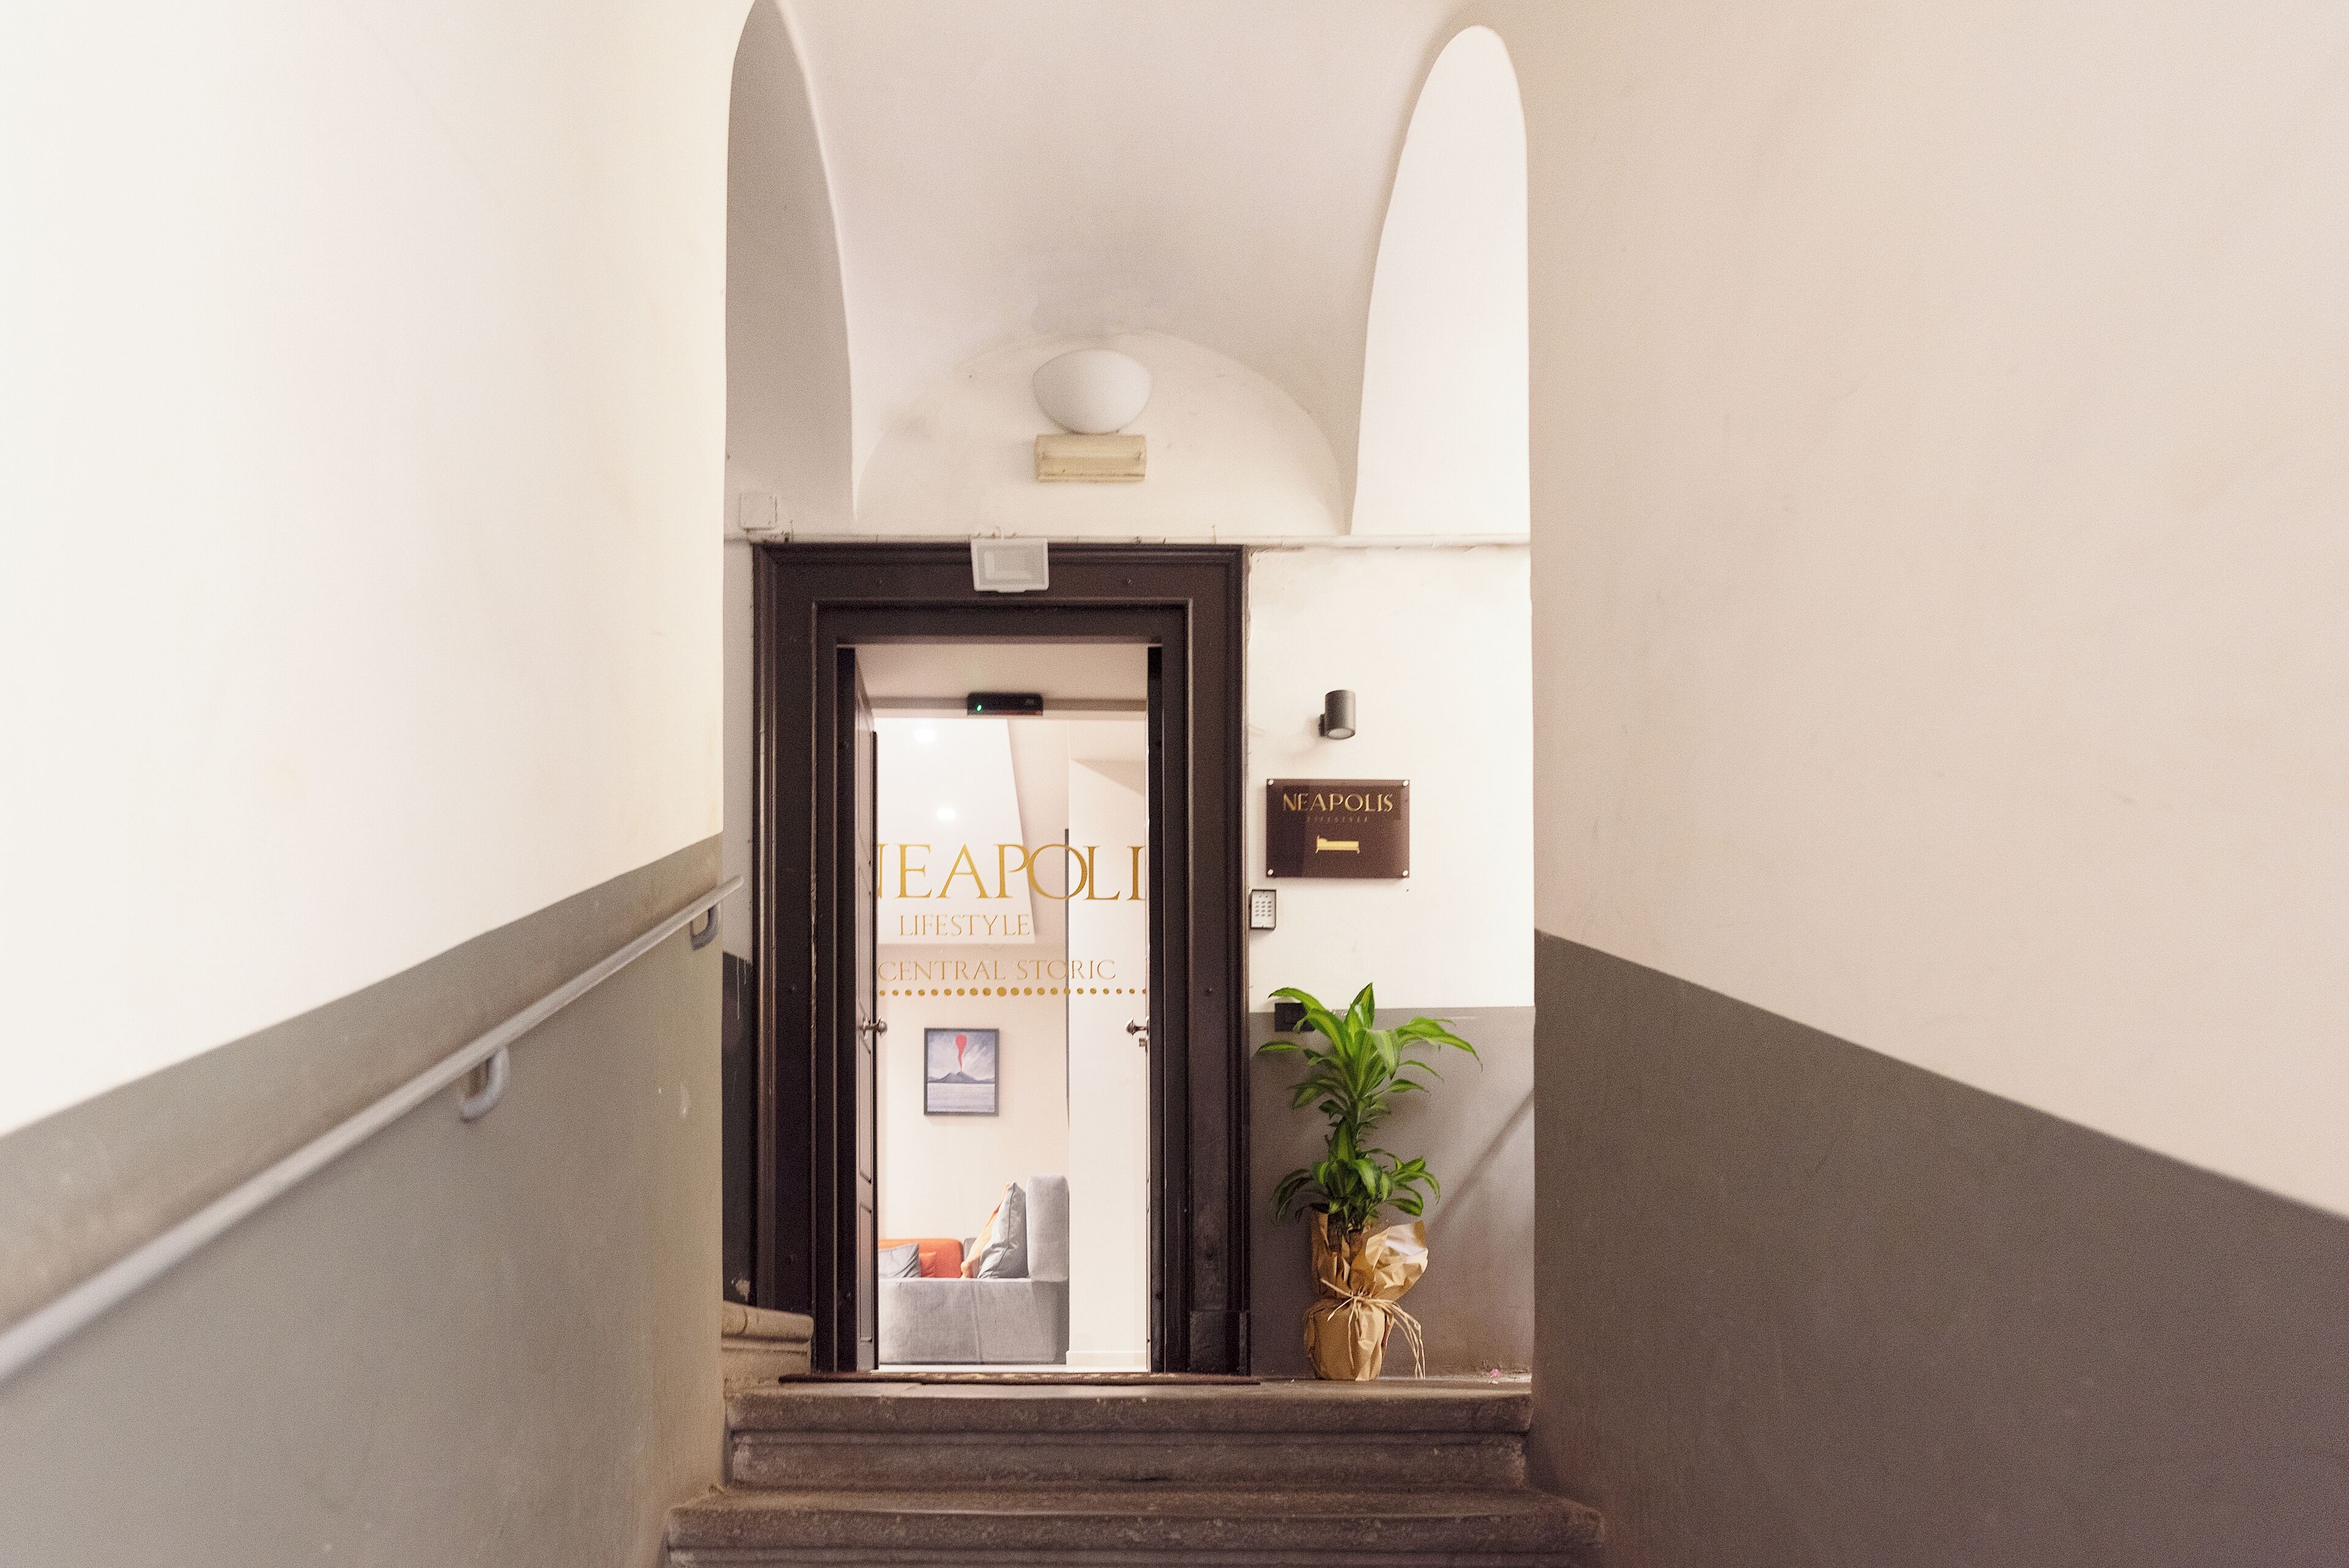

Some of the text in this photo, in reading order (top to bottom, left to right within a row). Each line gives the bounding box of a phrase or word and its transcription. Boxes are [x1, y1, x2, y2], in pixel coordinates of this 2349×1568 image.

[1282, 793, 1393, 812] NEAPOLIS
[899, 914, 1031, 937] LIFESTYLE
[877, 959, 1116, 981] CENTRAL STORIC
